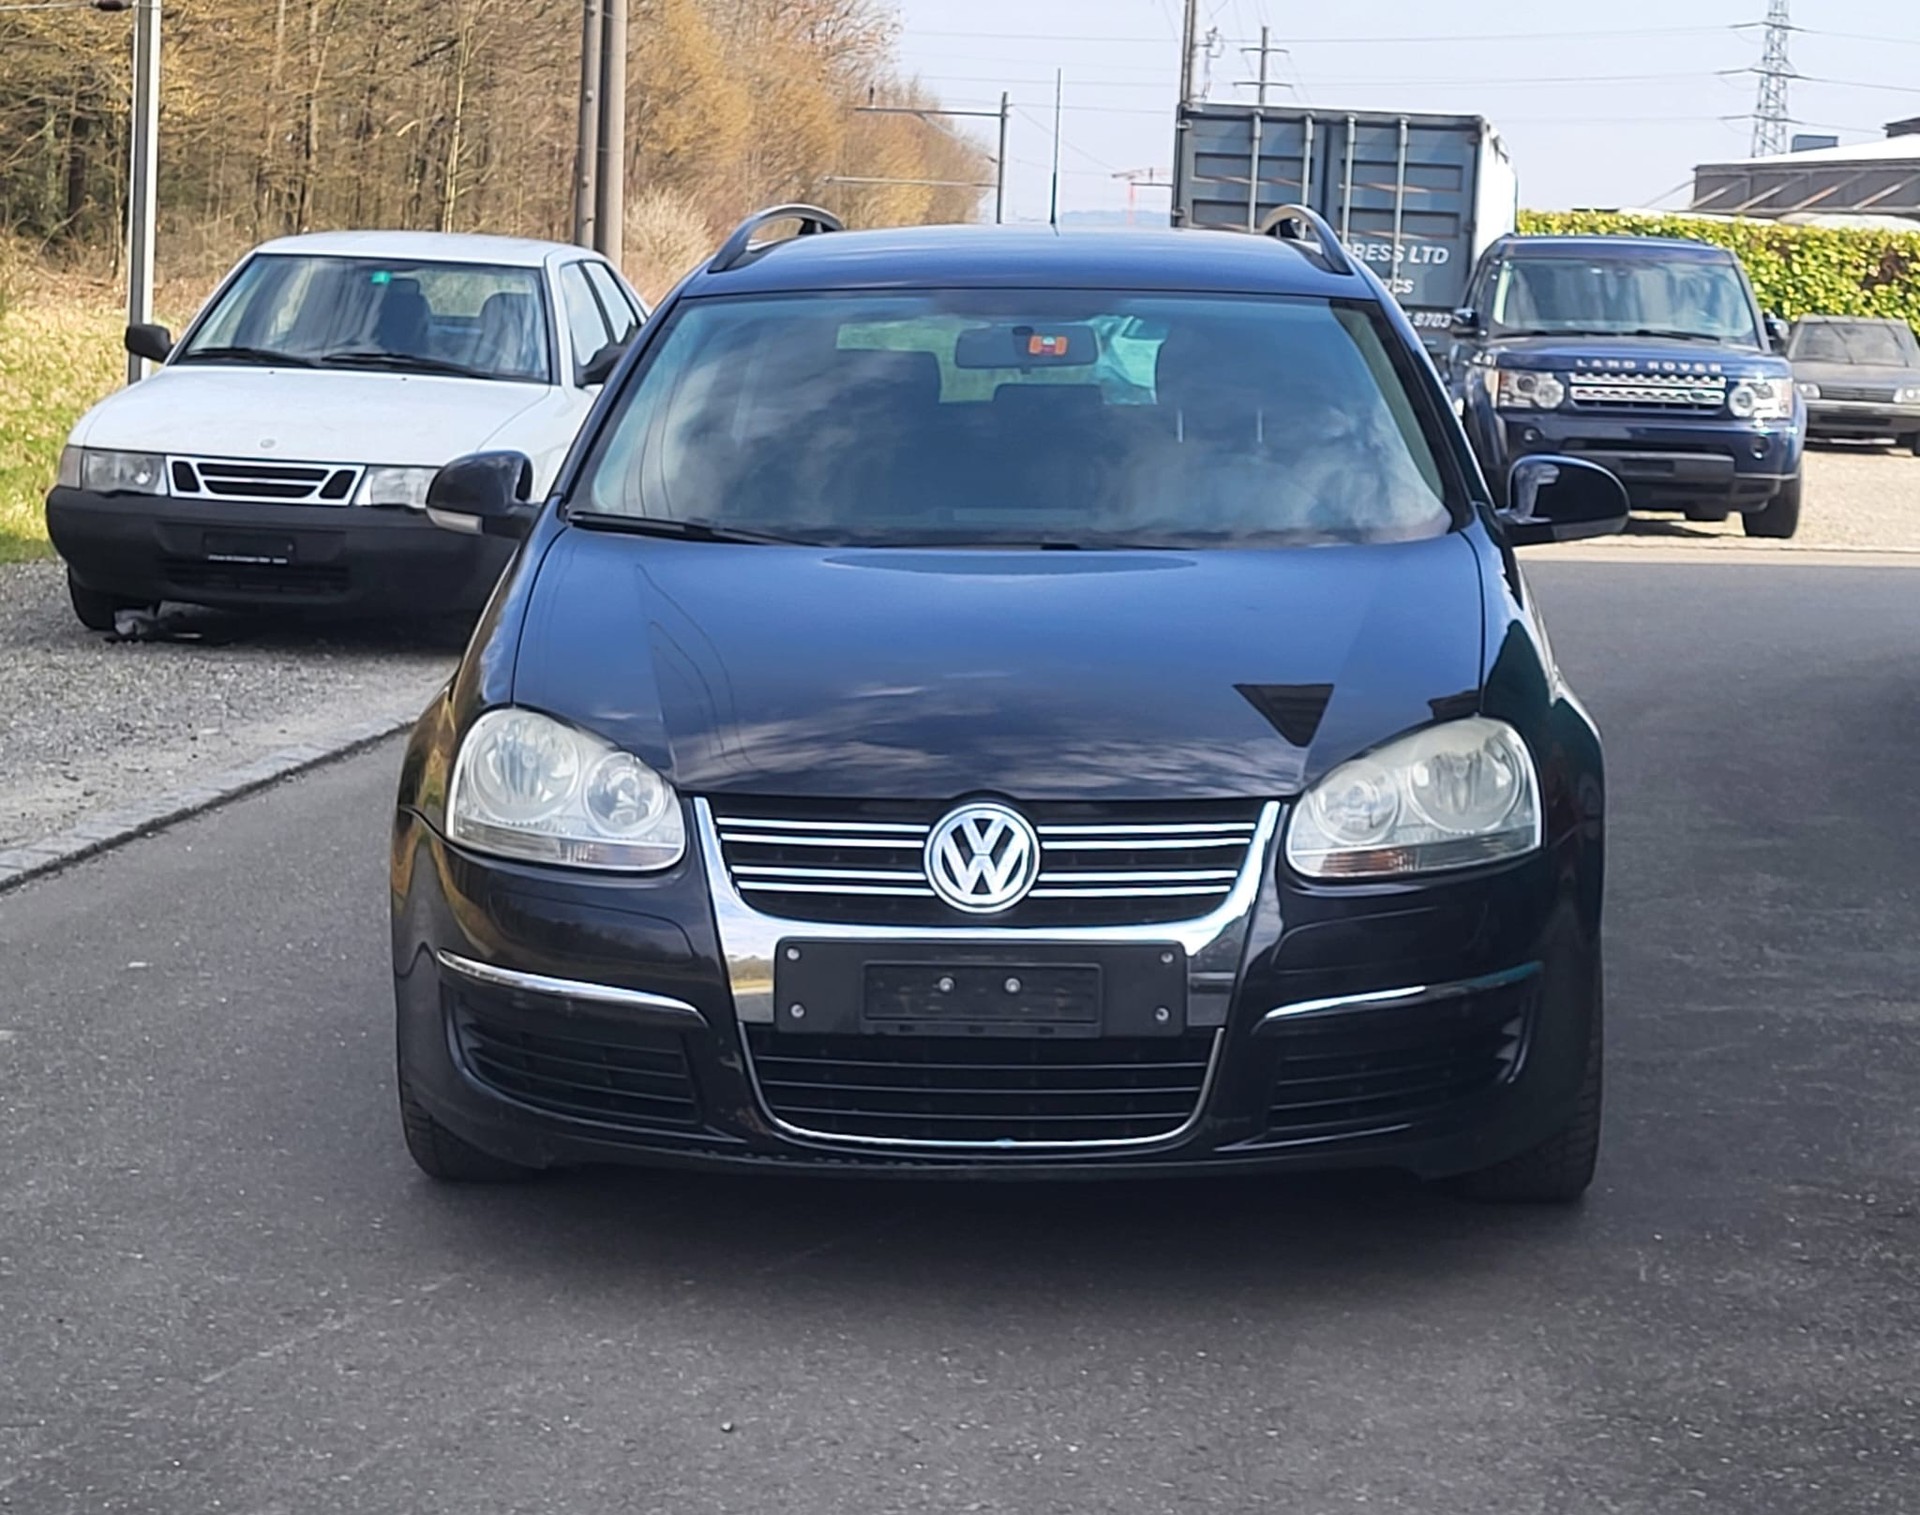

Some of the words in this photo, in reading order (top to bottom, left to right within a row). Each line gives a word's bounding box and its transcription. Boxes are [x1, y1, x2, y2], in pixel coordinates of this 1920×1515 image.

[1409, 245, 1449, 264] LTD
[1576, 359, 1636, 370] LAND
[1647, 361, 1722, 373] ROVER
